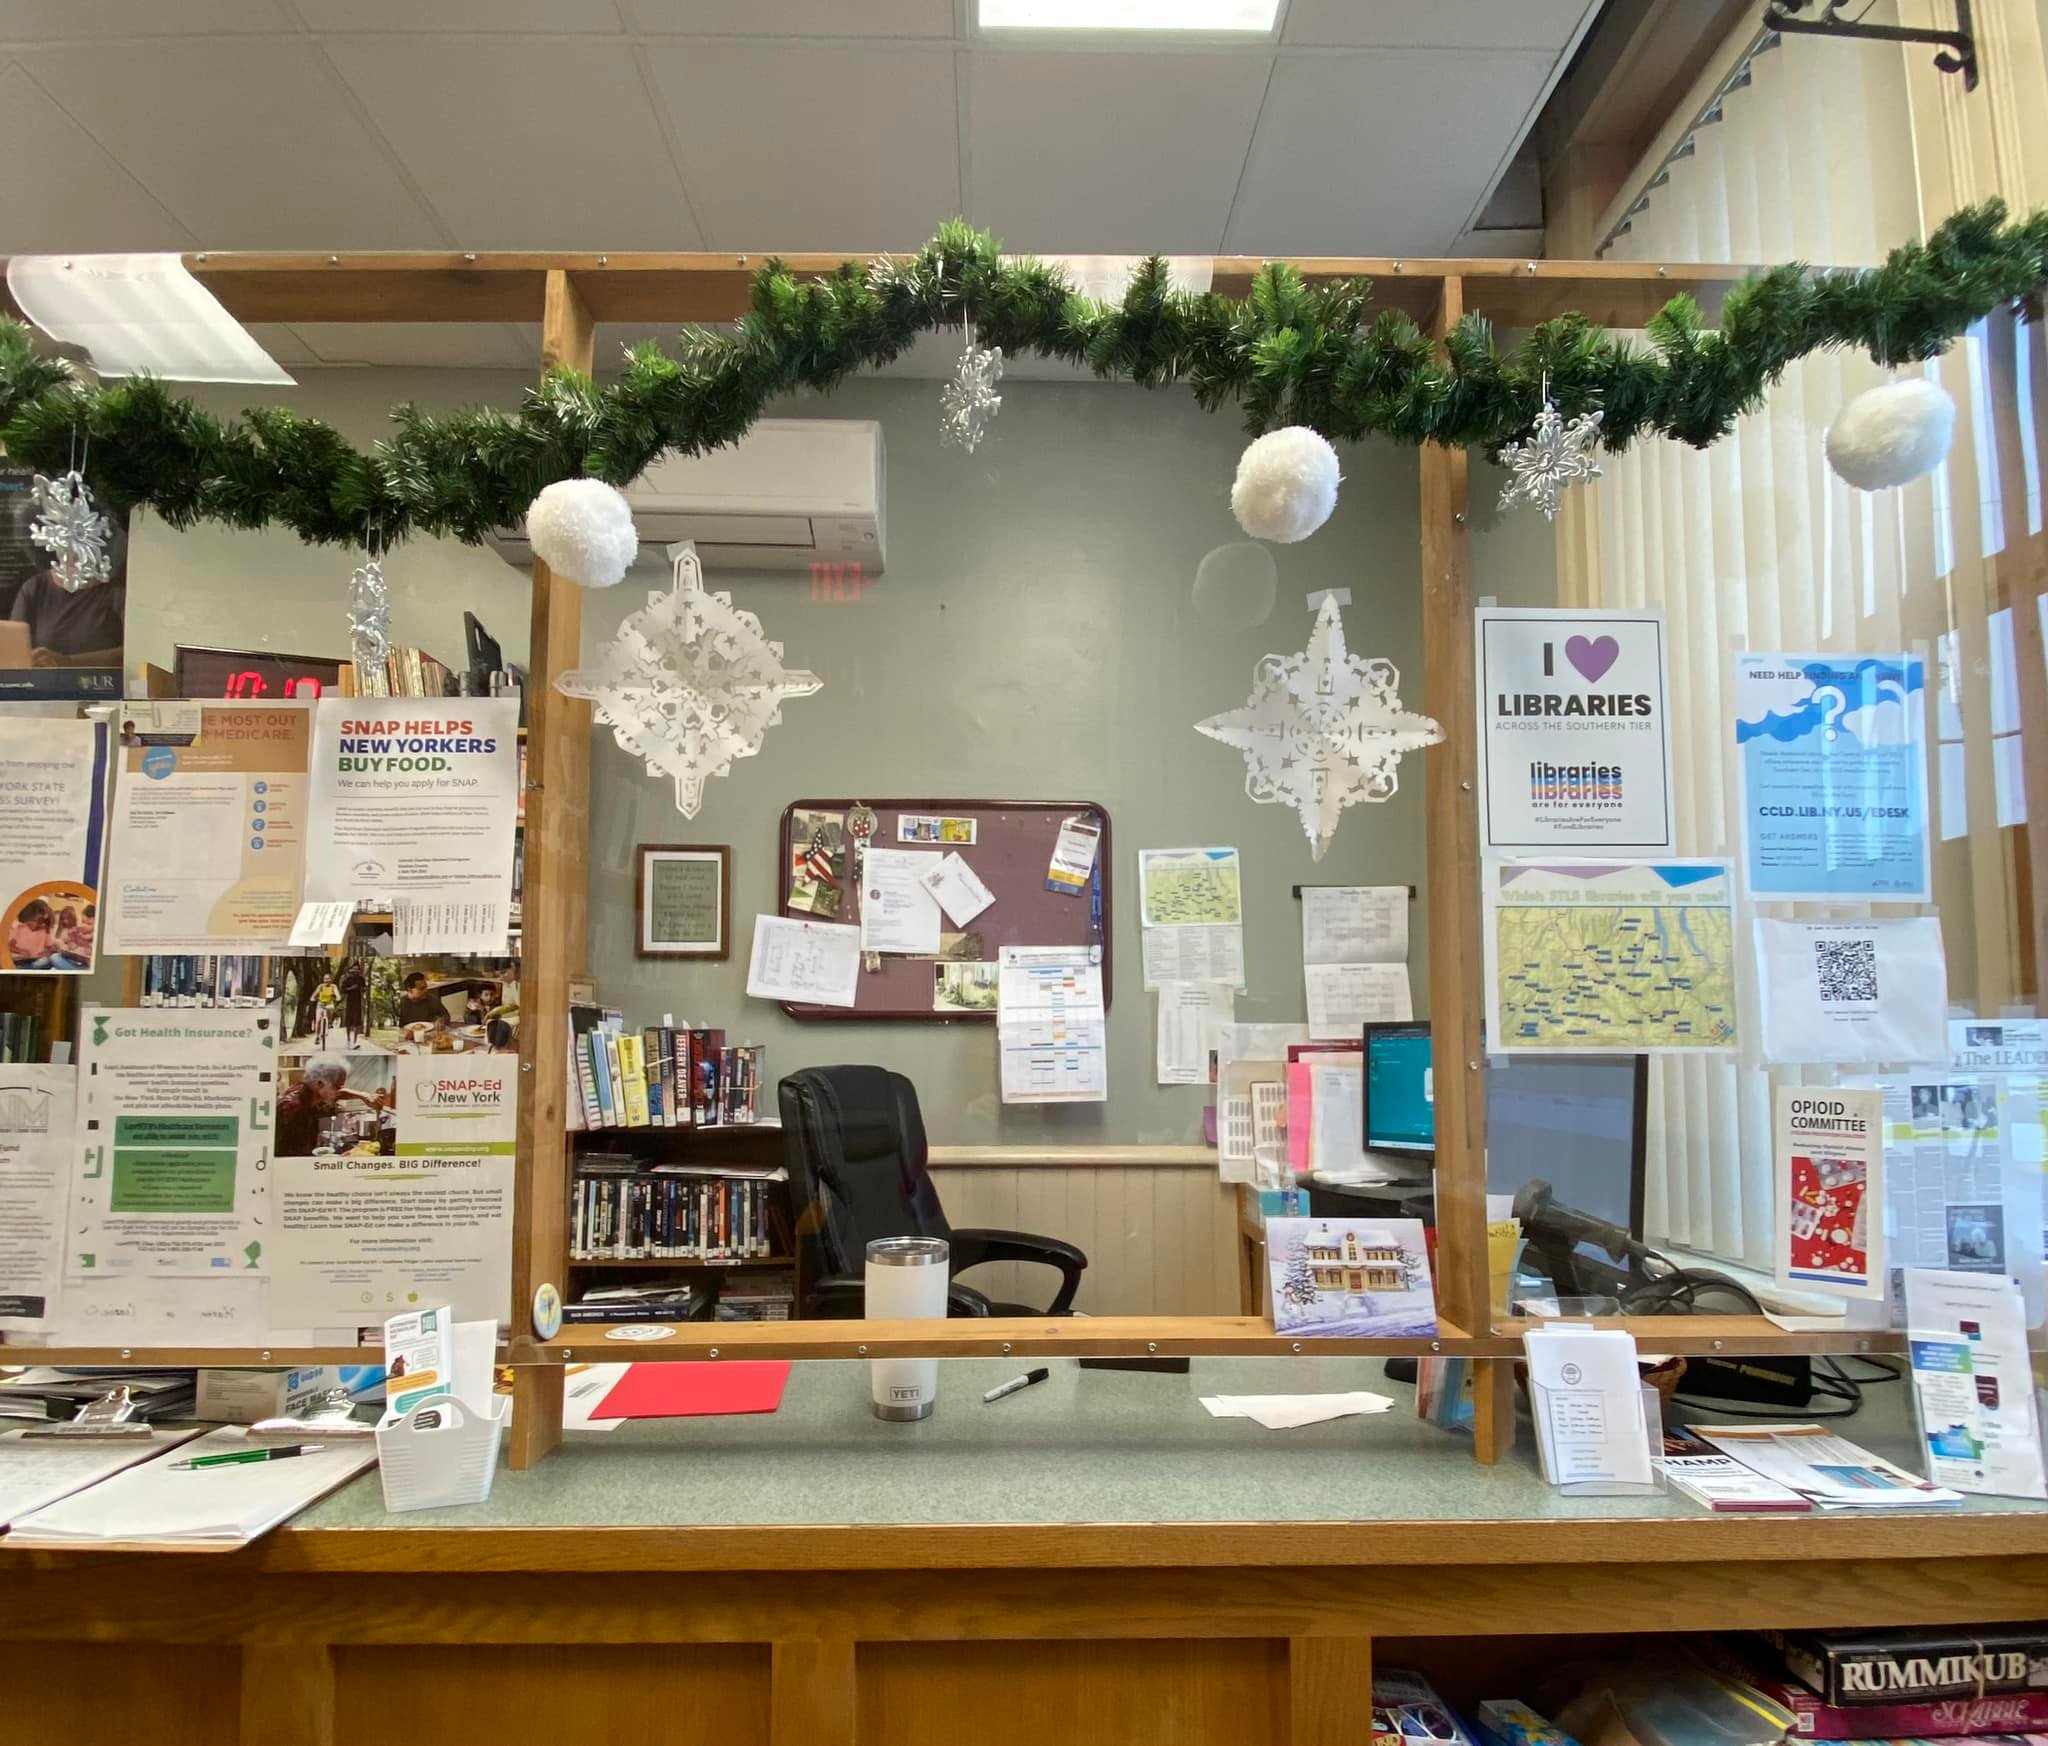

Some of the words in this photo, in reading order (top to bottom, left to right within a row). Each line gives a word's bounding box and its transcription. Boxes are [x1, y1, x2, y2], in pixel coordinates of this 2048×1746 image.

[1543, 642, 1554, 677] I
[1749, 671, 1775, 680] NEED
[1778, 671, 1801, 680] HELP
[1498, 693, 1652, 717] LIBRARIES
[221, 715, 261, 726] MOST
[267, 714, 296, 726] OUT
[1495, 721, 1541, 731] ACROSS
[1542, 721, 1562, 731] THE
[1566, 721, 1626, 731] SOUTHERN
[1629, 721, 1652, 731] TIER
[340, 720, 400, 735] SNAP
[405, 720, 473, 735] HELPS
[339, 738, 391, 753] NEW
[396, 738, 497, 753] YORKERS
[338, 757, 383, 772] BUY
[386, 757, 452, 772] FOOD.
[31, 782, 65, 792] STATE
[338, 780, 353, 788] We
[373, 780, 392, 789] help
[394, 781, 409, 790] you
[411, 780, 434, 790] apply
[436, 779, 450, 788] for
[452, 779, 479, 788] SNAP.
[1553, 800, 1568, 808] for
[1572, 801, 1623, 810] everyone
[115, 1028, 136, 1037] Got
[140, 1027, 181, 1037] Health
[184, 1028, 253, 1038] Insurance?
[1963, 1051, 1993, 1065] The
[1995, 1050, 2048, 1065] LEADE
[438, 1080, 502, 1091] SNAP-Ed
[437, 1092, 468, 1103] New
[471, 1092, 501, 1103] York
[1791, 1100, 1845, 1116] OPIOID
[1791, 1116, 1867, 1132] COMMITTEE
[313, 1161, 343, 1170] Small
[346, 1160, 395, 1171] Changes.
[399, 1160, 418, 1169] BIG
[422, 1158, 481, 1169] Difference!
[893, 1389, 919, 1399] YETI
[1842, 1652, 2027, 1692] RUMMIKUB
